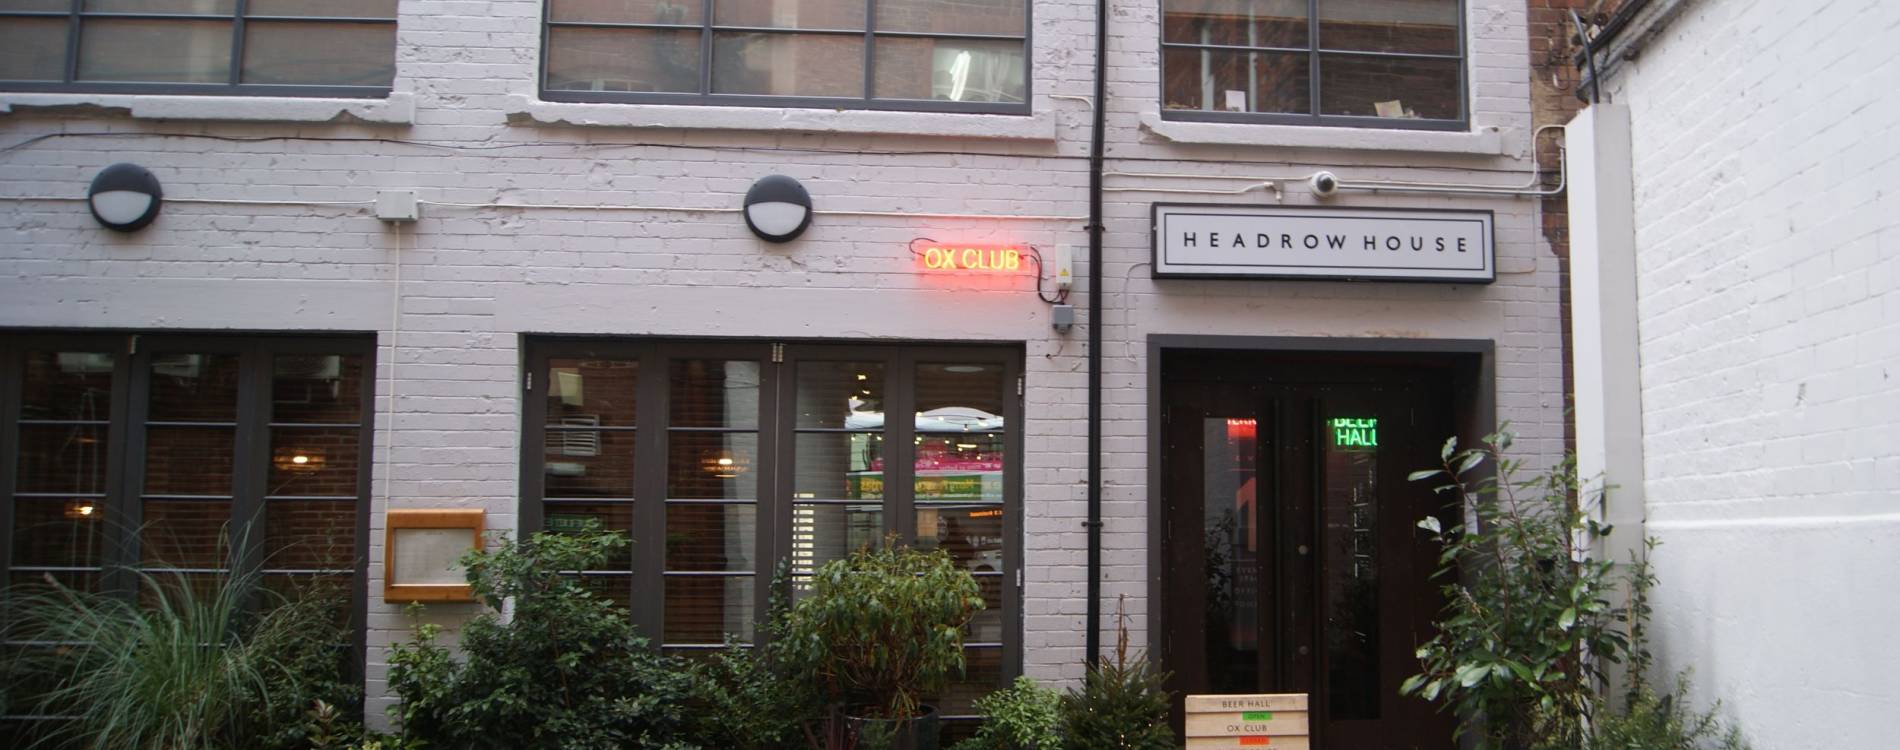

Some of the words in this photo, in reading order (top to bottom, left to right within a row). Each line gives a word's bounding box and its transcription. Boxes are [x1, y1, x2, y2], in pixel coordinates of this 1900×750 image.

[1183, 232, 1346, 250] HEADROW
[1363, 235, 1467, 252] HOUSE
[924, 248, 956, 269] OX
[962, 248, 1019, 270] CLUB
[1247, 700, 1271, 708] HALL
